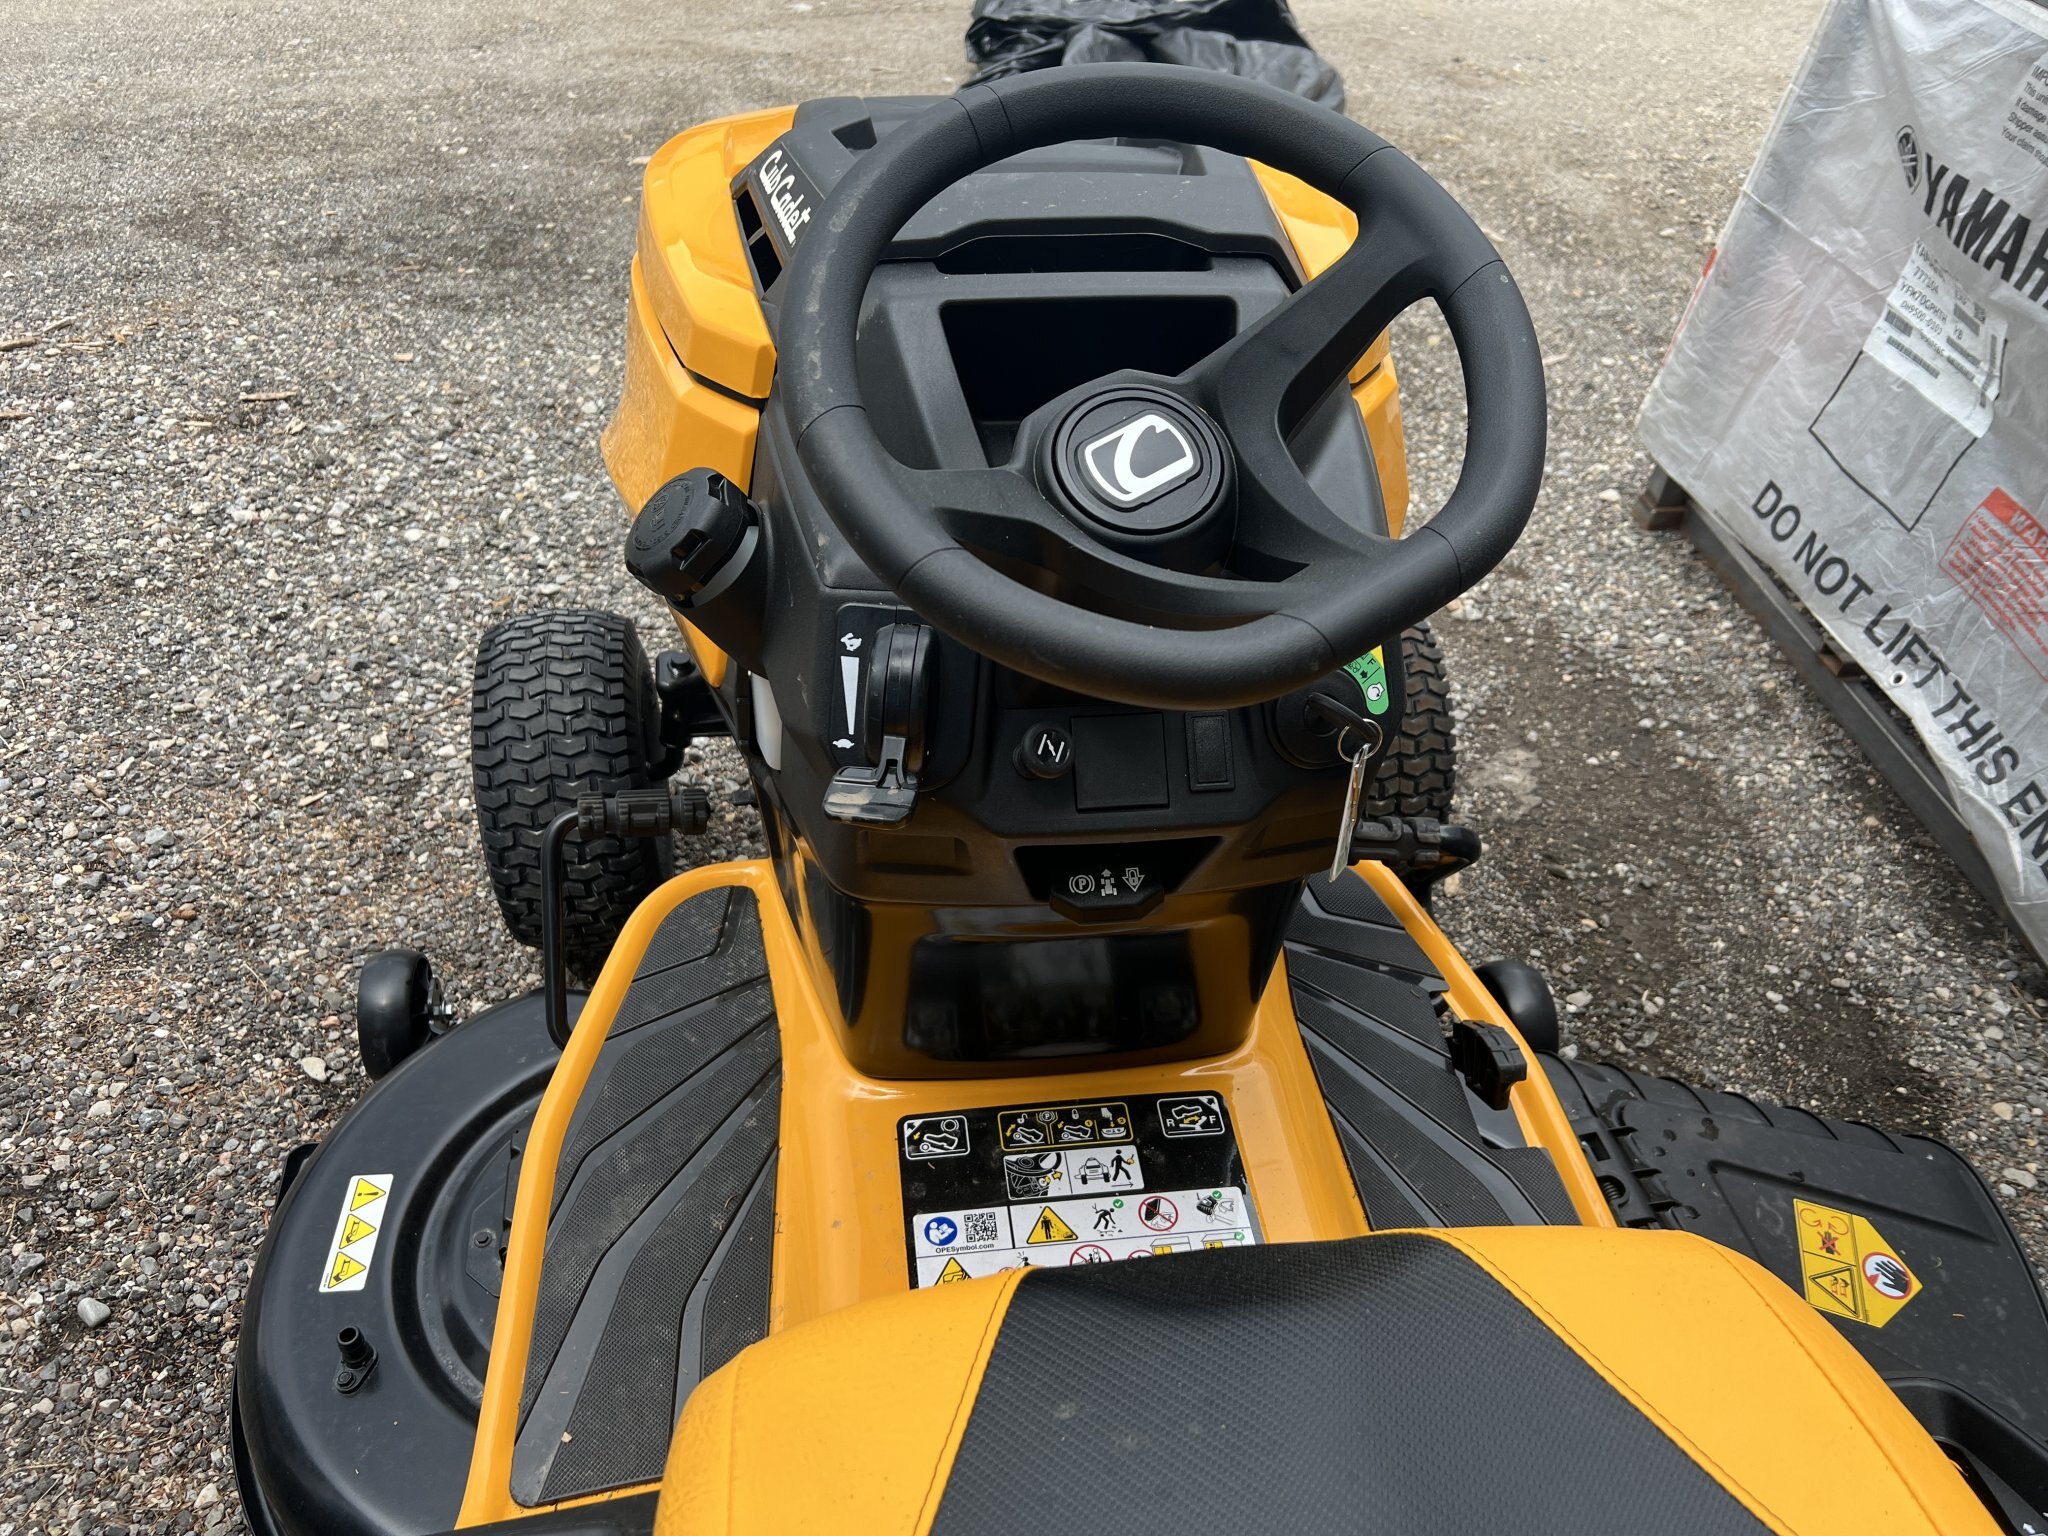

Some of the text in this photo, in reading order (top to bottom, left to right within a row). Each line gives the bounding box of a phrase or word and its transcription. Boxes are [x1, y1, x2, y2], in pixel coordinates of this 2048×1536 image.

[759, 150, 811, 245] Cub Cadet
[1924, 152, 2048, 312] YAMAH
[1752, 479, 1801, 542] DO
[1793, 530, 1874, 613] NOT
[1863, 603, 1950, 688] LIFT
[1931, 678, 2019, 785] THIS
[1999, 780, 2048, 880] EN
[1166, 1115, 1216, 1127] R F
[935, 1243, 994, 1254] OPESymbol.com
